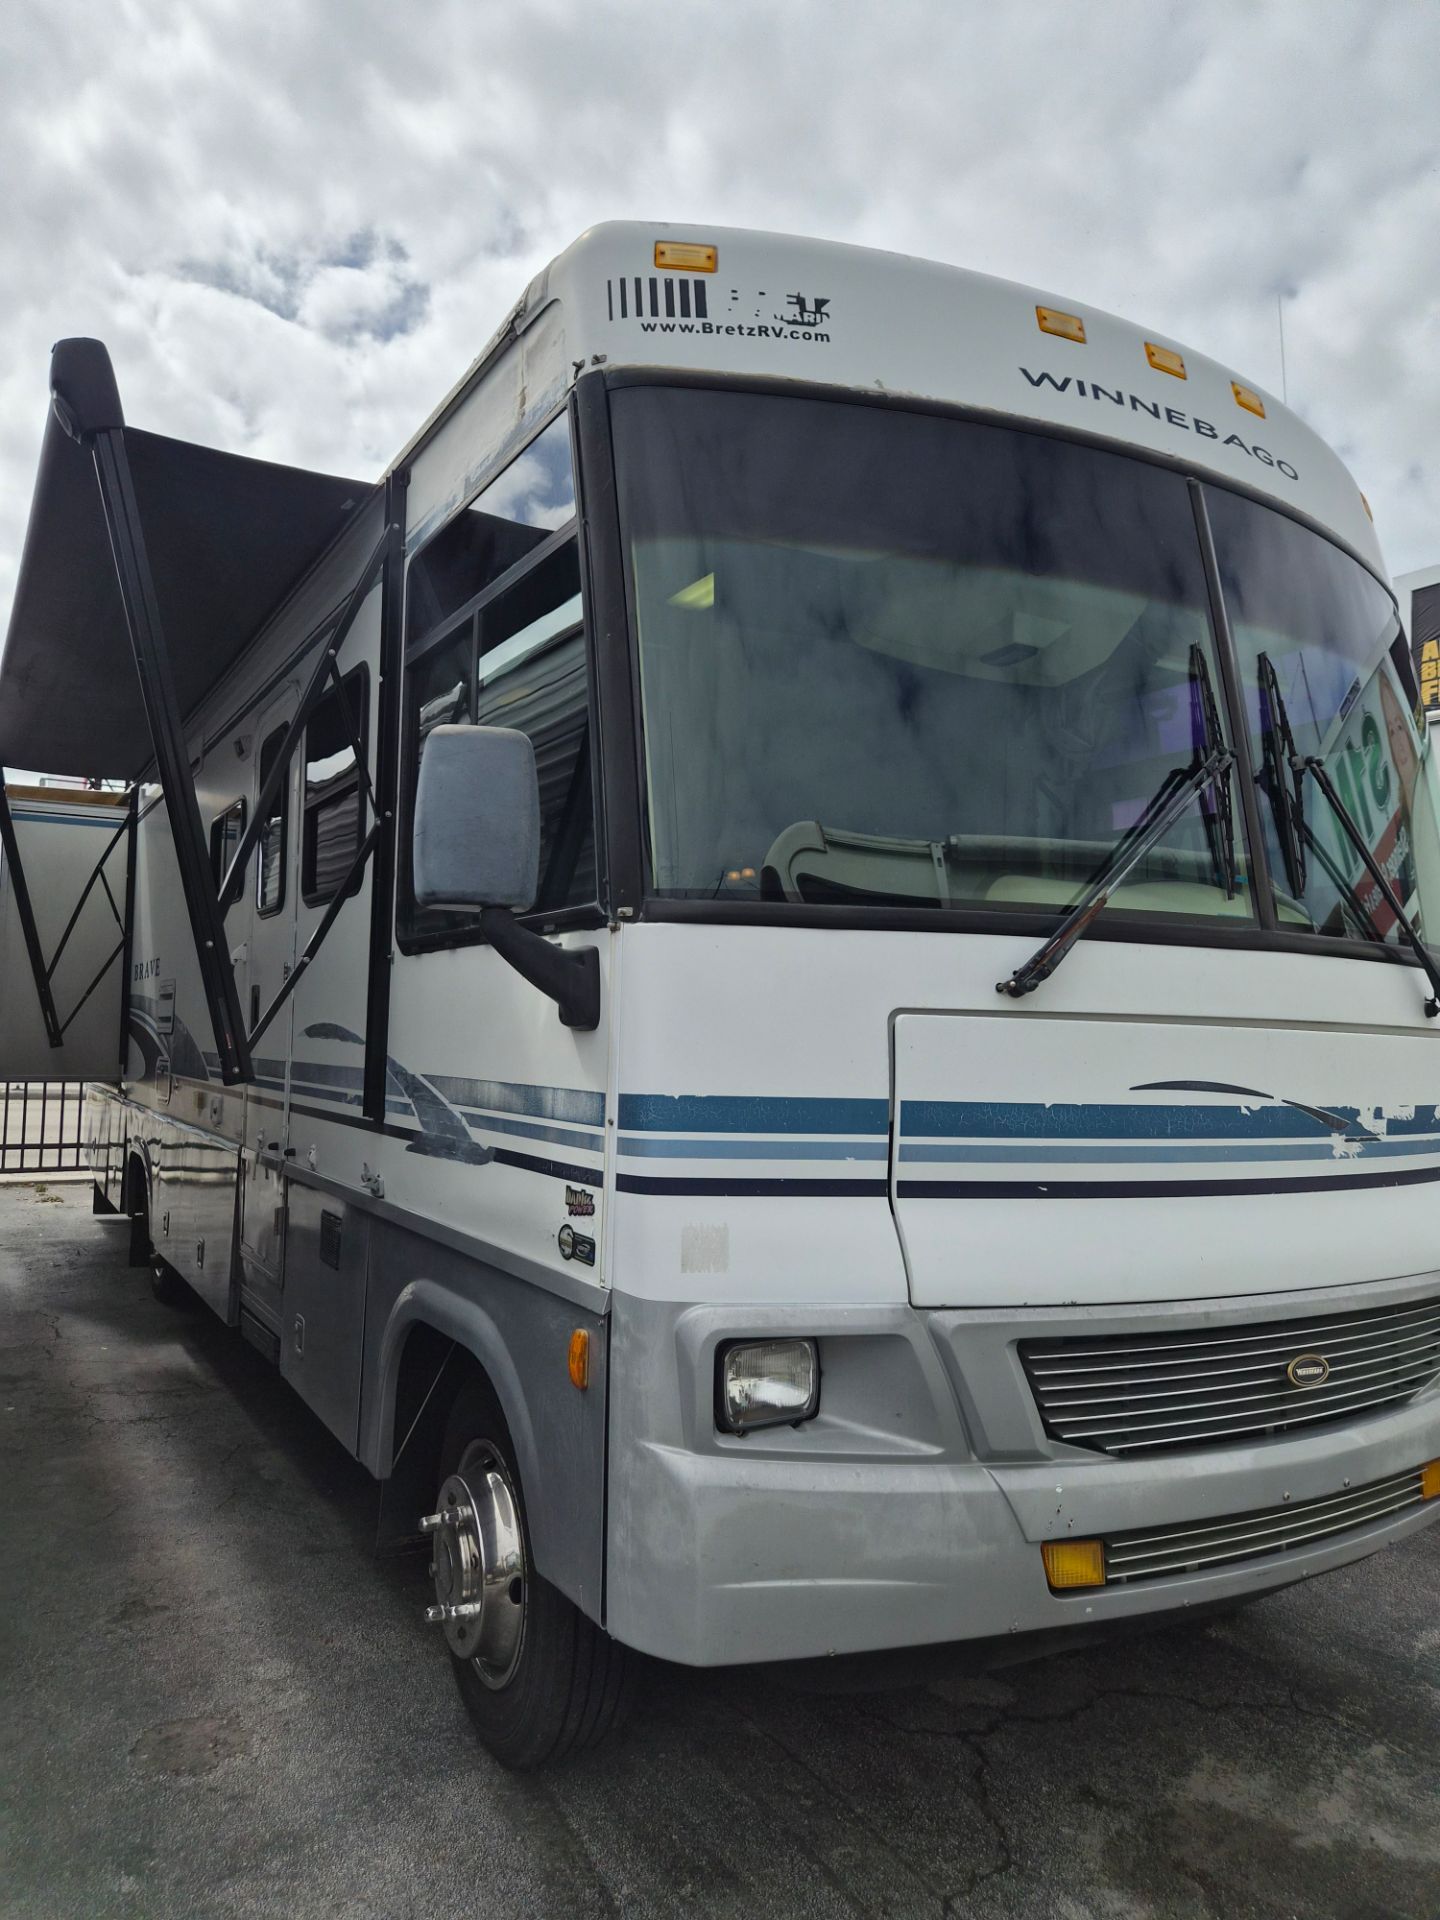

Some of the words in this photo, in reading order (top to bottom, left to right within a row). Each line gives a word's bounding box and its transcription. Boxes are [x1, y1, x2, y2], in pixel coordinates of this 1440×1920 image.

[641, 321, 831, 343] www.BretzRV.com
[1019, 366, 1299, 481] WINNEBAGO
[134, 958, 161, 981] BRAVE
